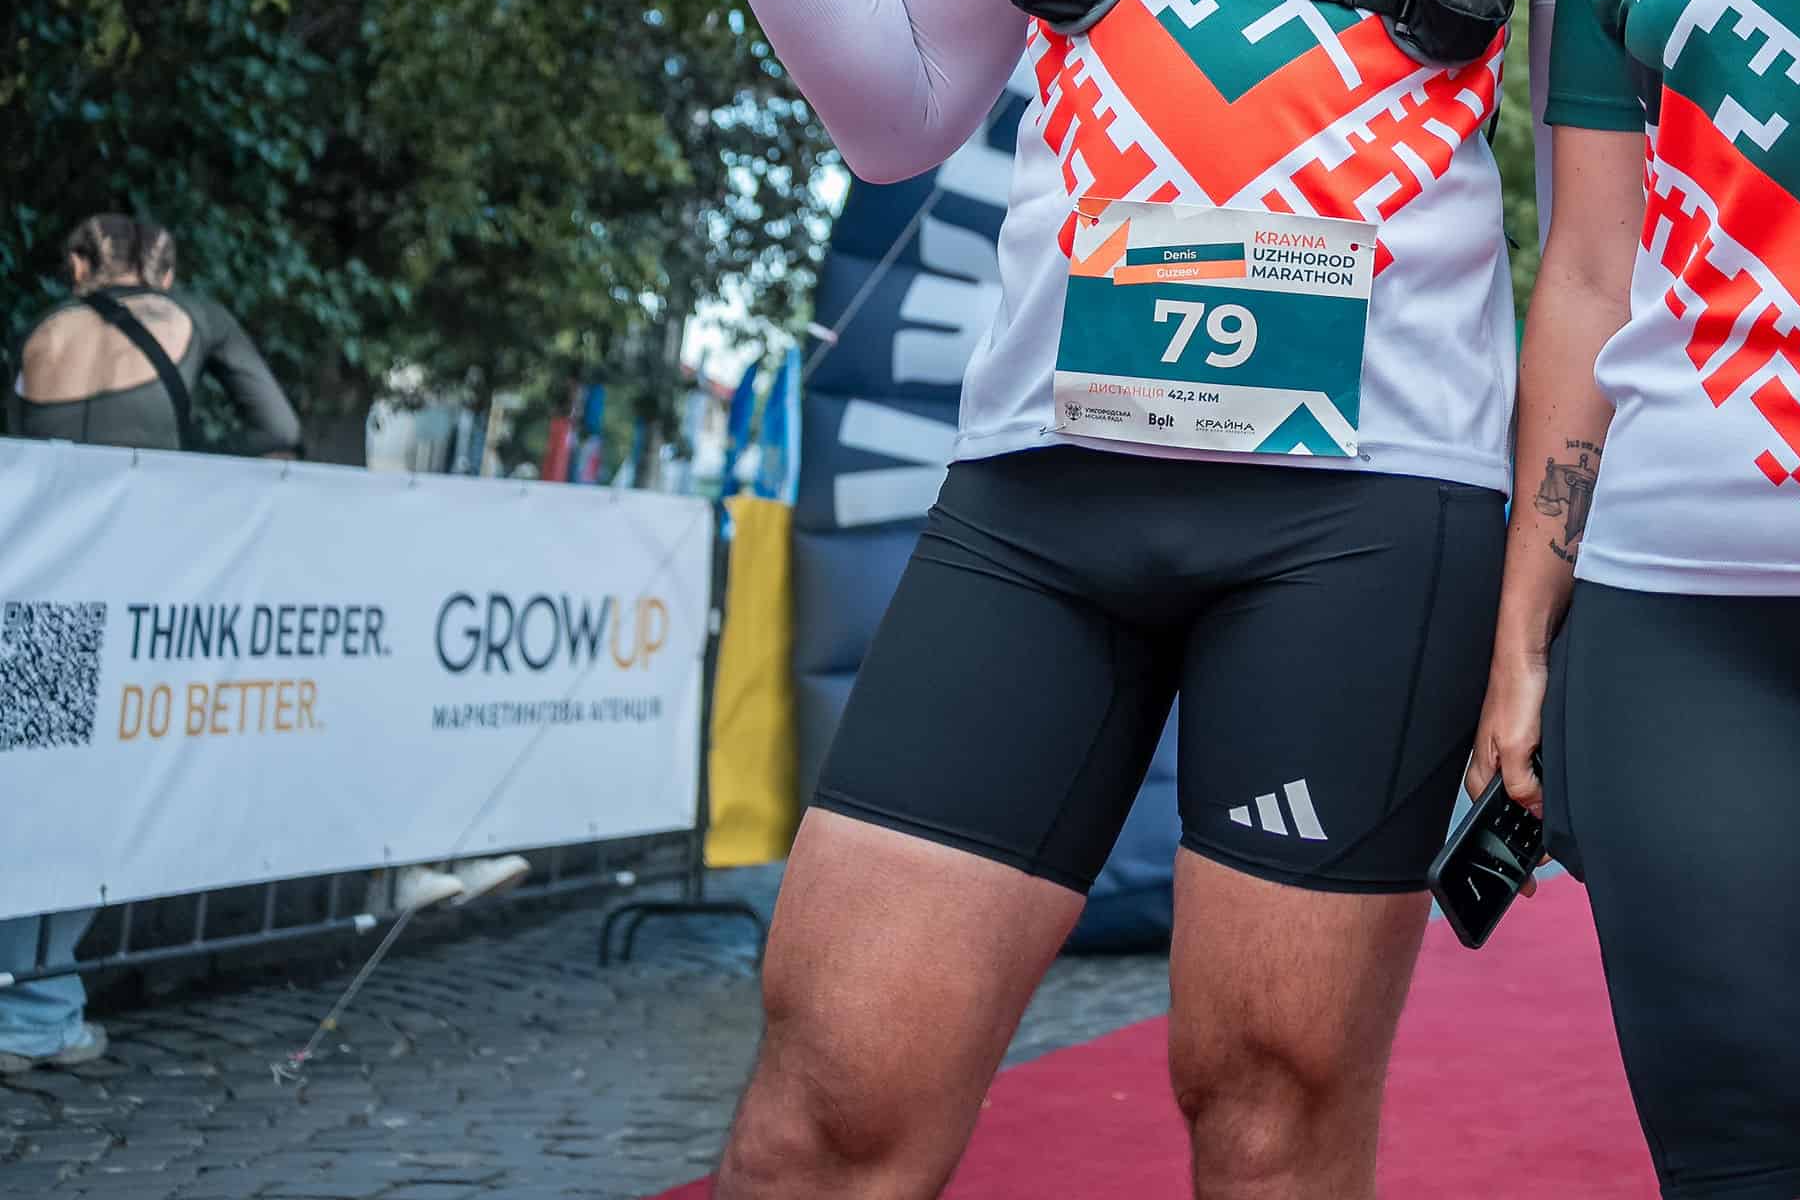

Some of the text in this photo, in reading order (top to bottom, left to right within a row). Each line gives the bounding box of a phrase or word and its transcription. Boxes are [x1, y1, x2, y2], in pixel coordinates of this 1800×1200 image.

[1254, 231, 1327, 250] KRAYNA
[1163, 249, 1197, 261] Denis
[1252, 248, 1356, 269] UZHHOROD
[1251, 266, 1354, 286] MARATHON
[1152, 298, 1258, 369] 79
[1167, 390, 1195, 403] 42,2
[1148, 413, 1175, 429] Bolt
[1195, 419, 1255, 431] КРАЙНА
[127, 602, 393, 661] THINK DEEPER.
[117, 679, 326, 741] DO BETTER.
